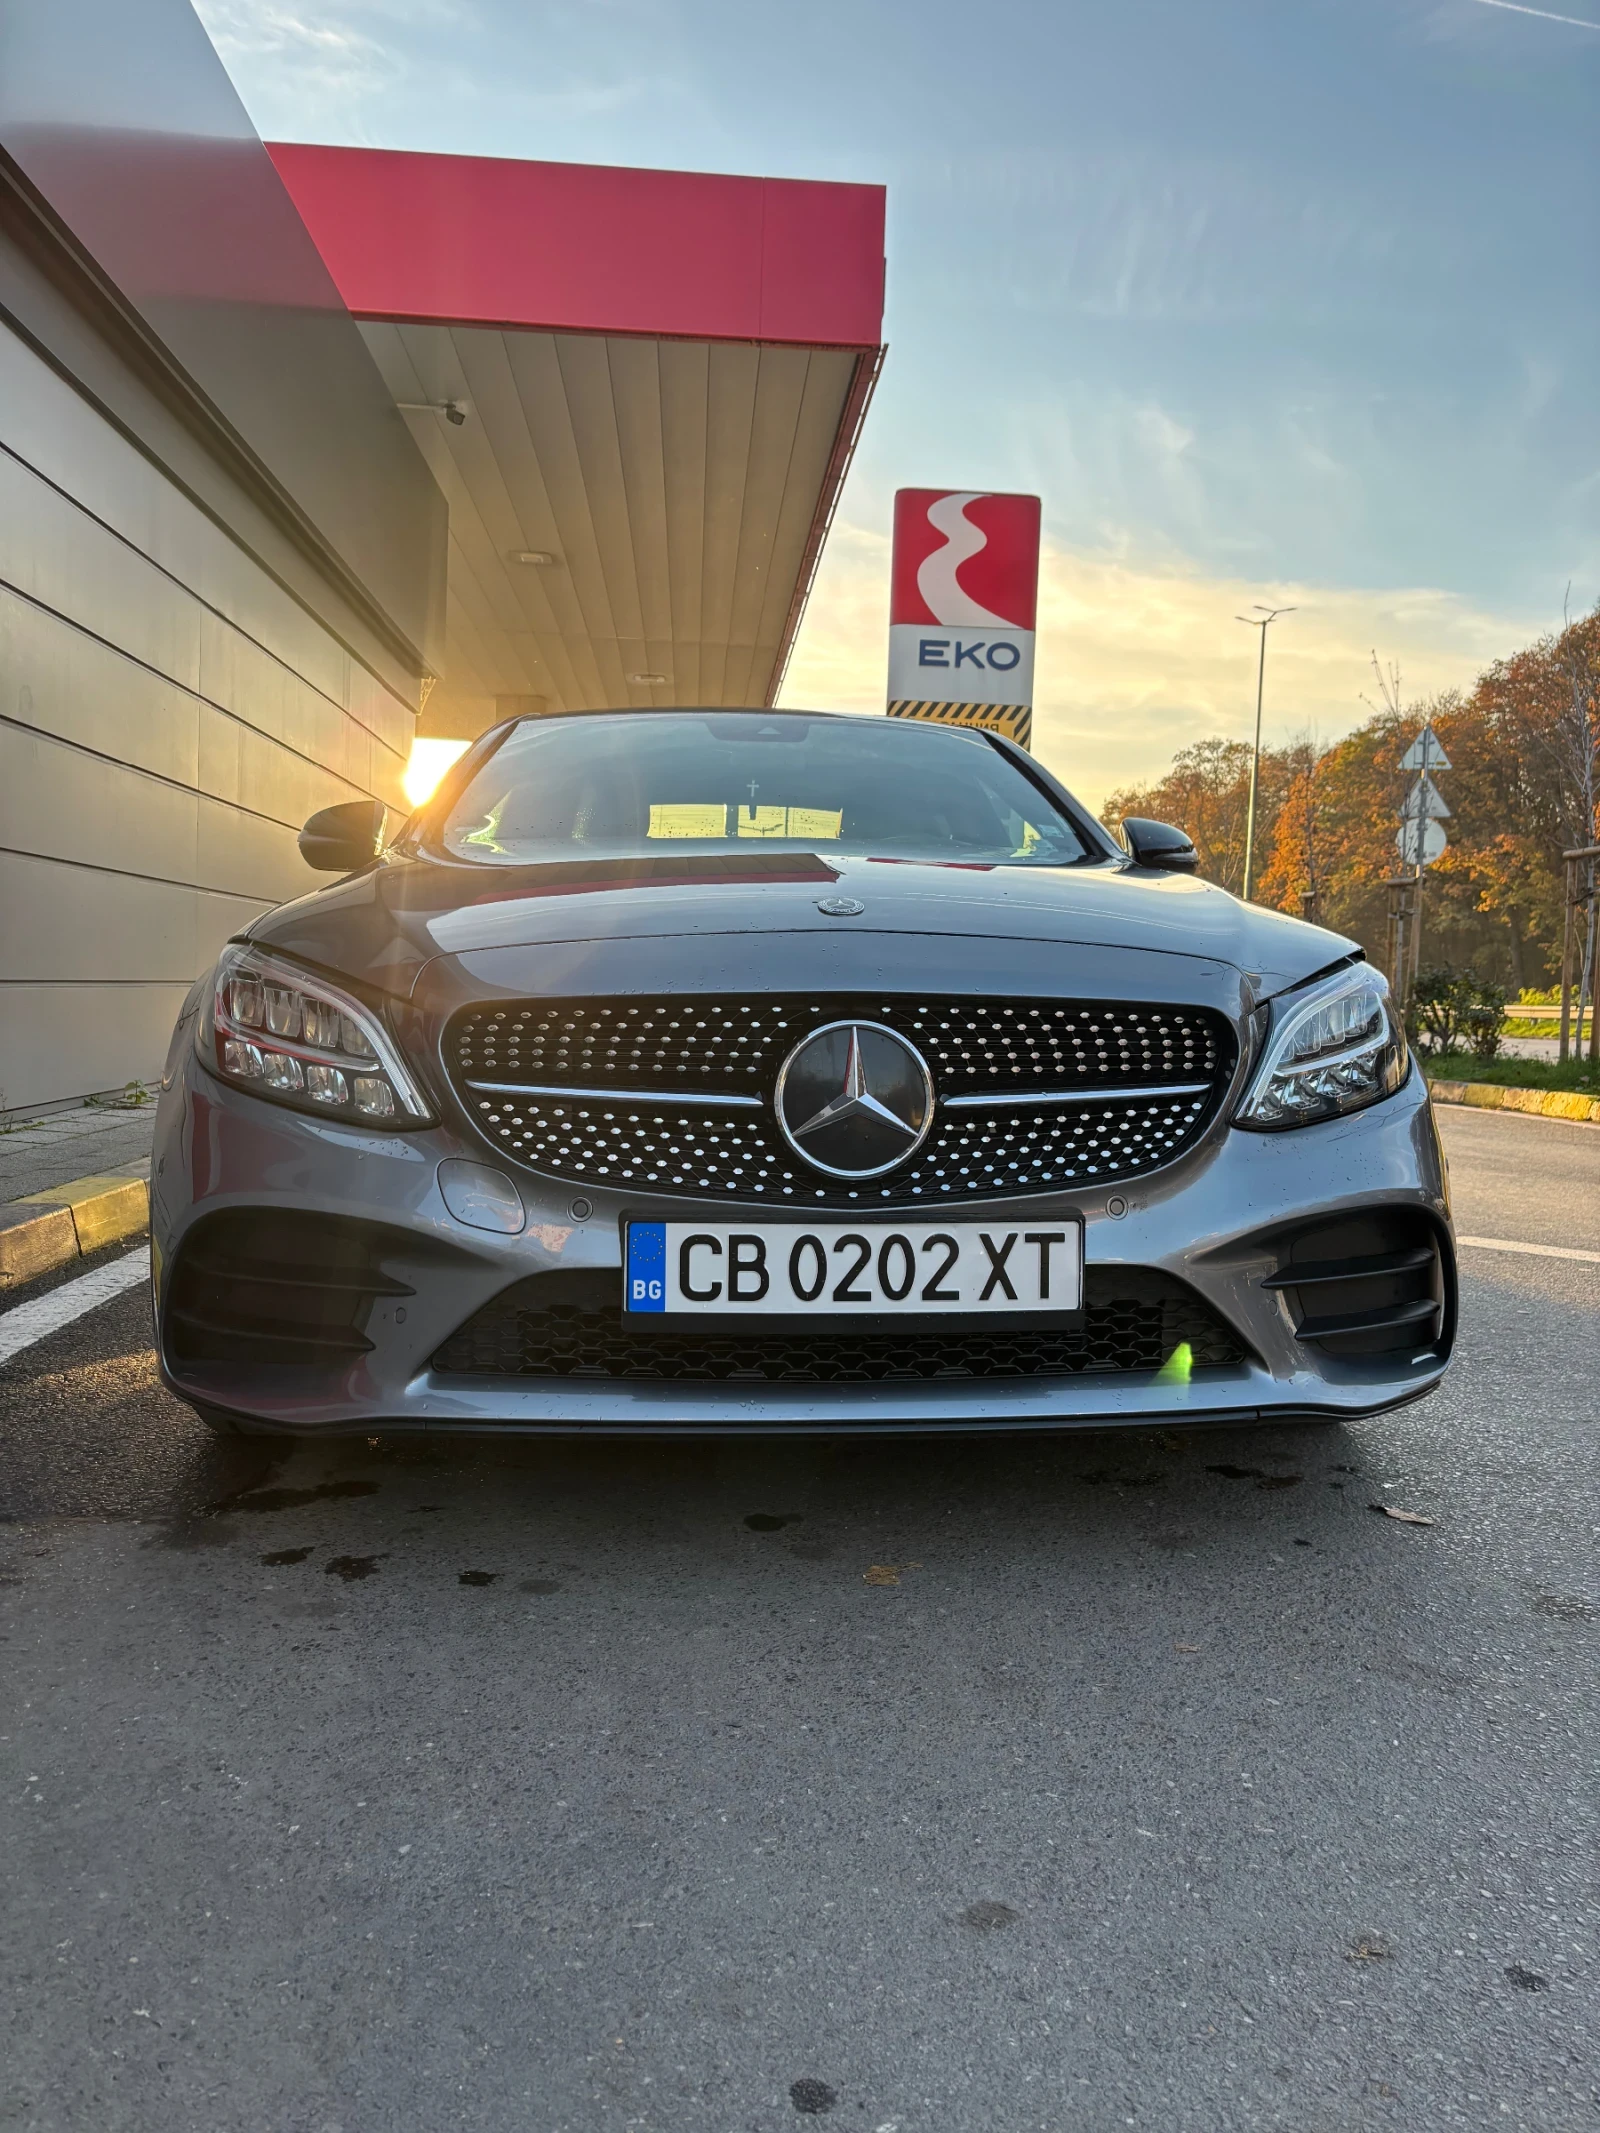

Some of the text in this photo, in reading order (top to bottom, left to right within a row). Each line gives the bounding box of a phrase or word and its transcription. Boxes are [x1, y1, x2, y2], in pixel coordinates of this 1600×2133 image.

[919, 639, 1021, 671] EKO
[680, 1232, 1066, 1302] CB 0202 XT
[633, 1279, 662, 1300] BG
